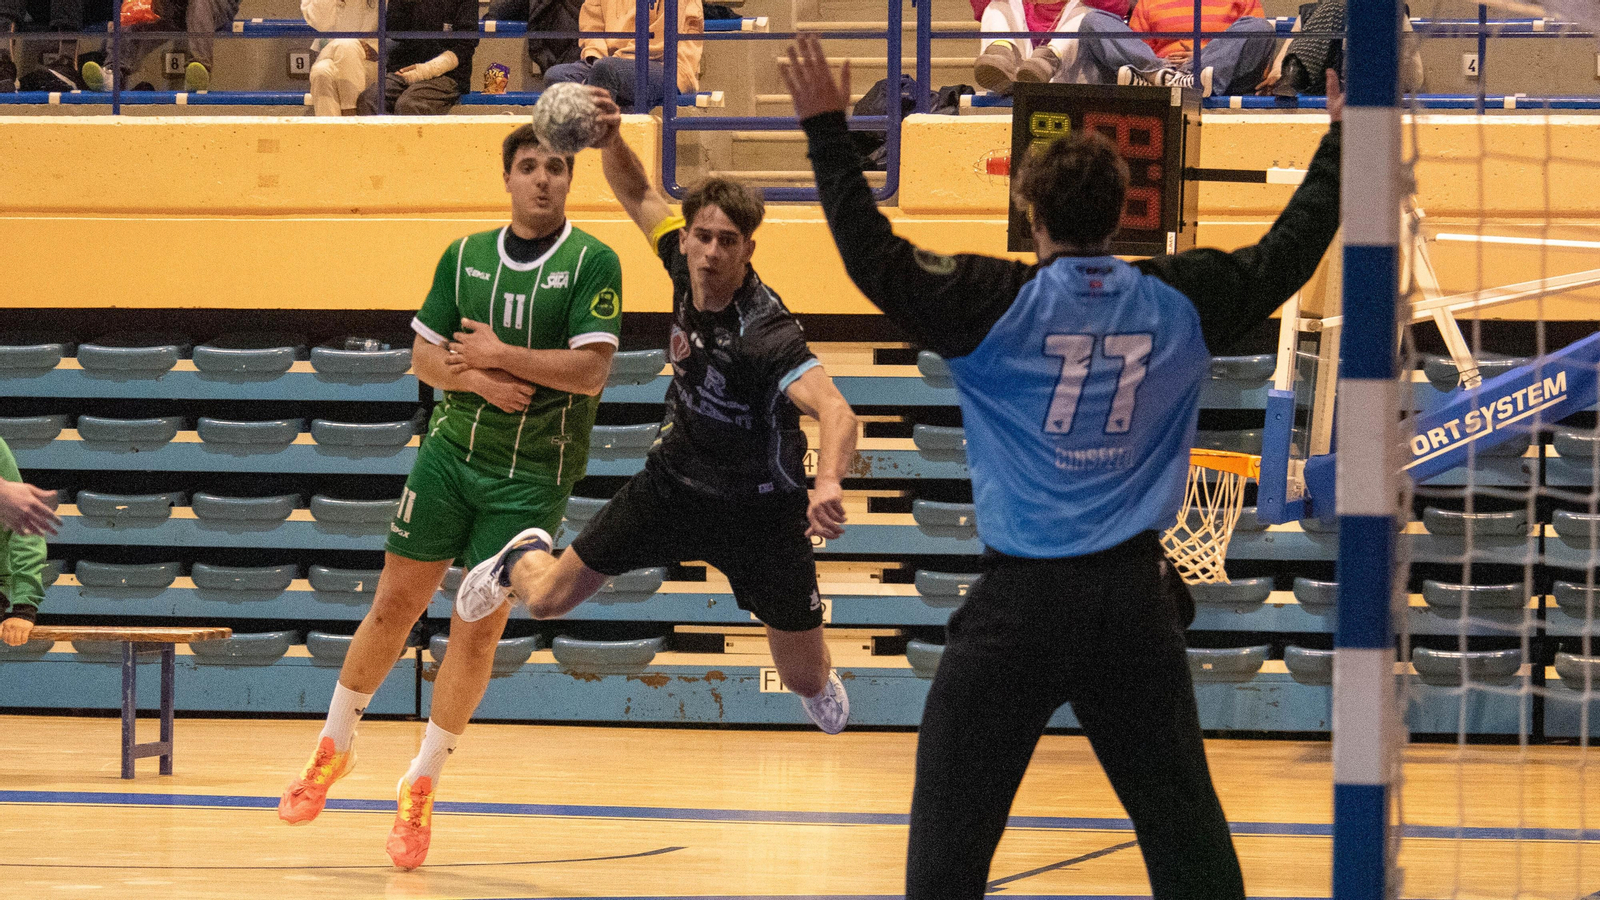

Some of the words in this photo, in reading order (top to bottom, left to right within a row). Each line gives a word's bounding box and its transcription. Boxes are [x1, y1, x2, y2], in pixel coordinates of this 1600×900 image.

[171, 57, 179, 70] 8
[295, 57, 304, 70] 9
[1468, 59, 1476, 72] 4
[503, 292, 526, 329] 11
[1042, 331, 1155, 435] 77
[1464, 371, 1568, 434] SYSTEM
[802, 452, 815, 473] 4
